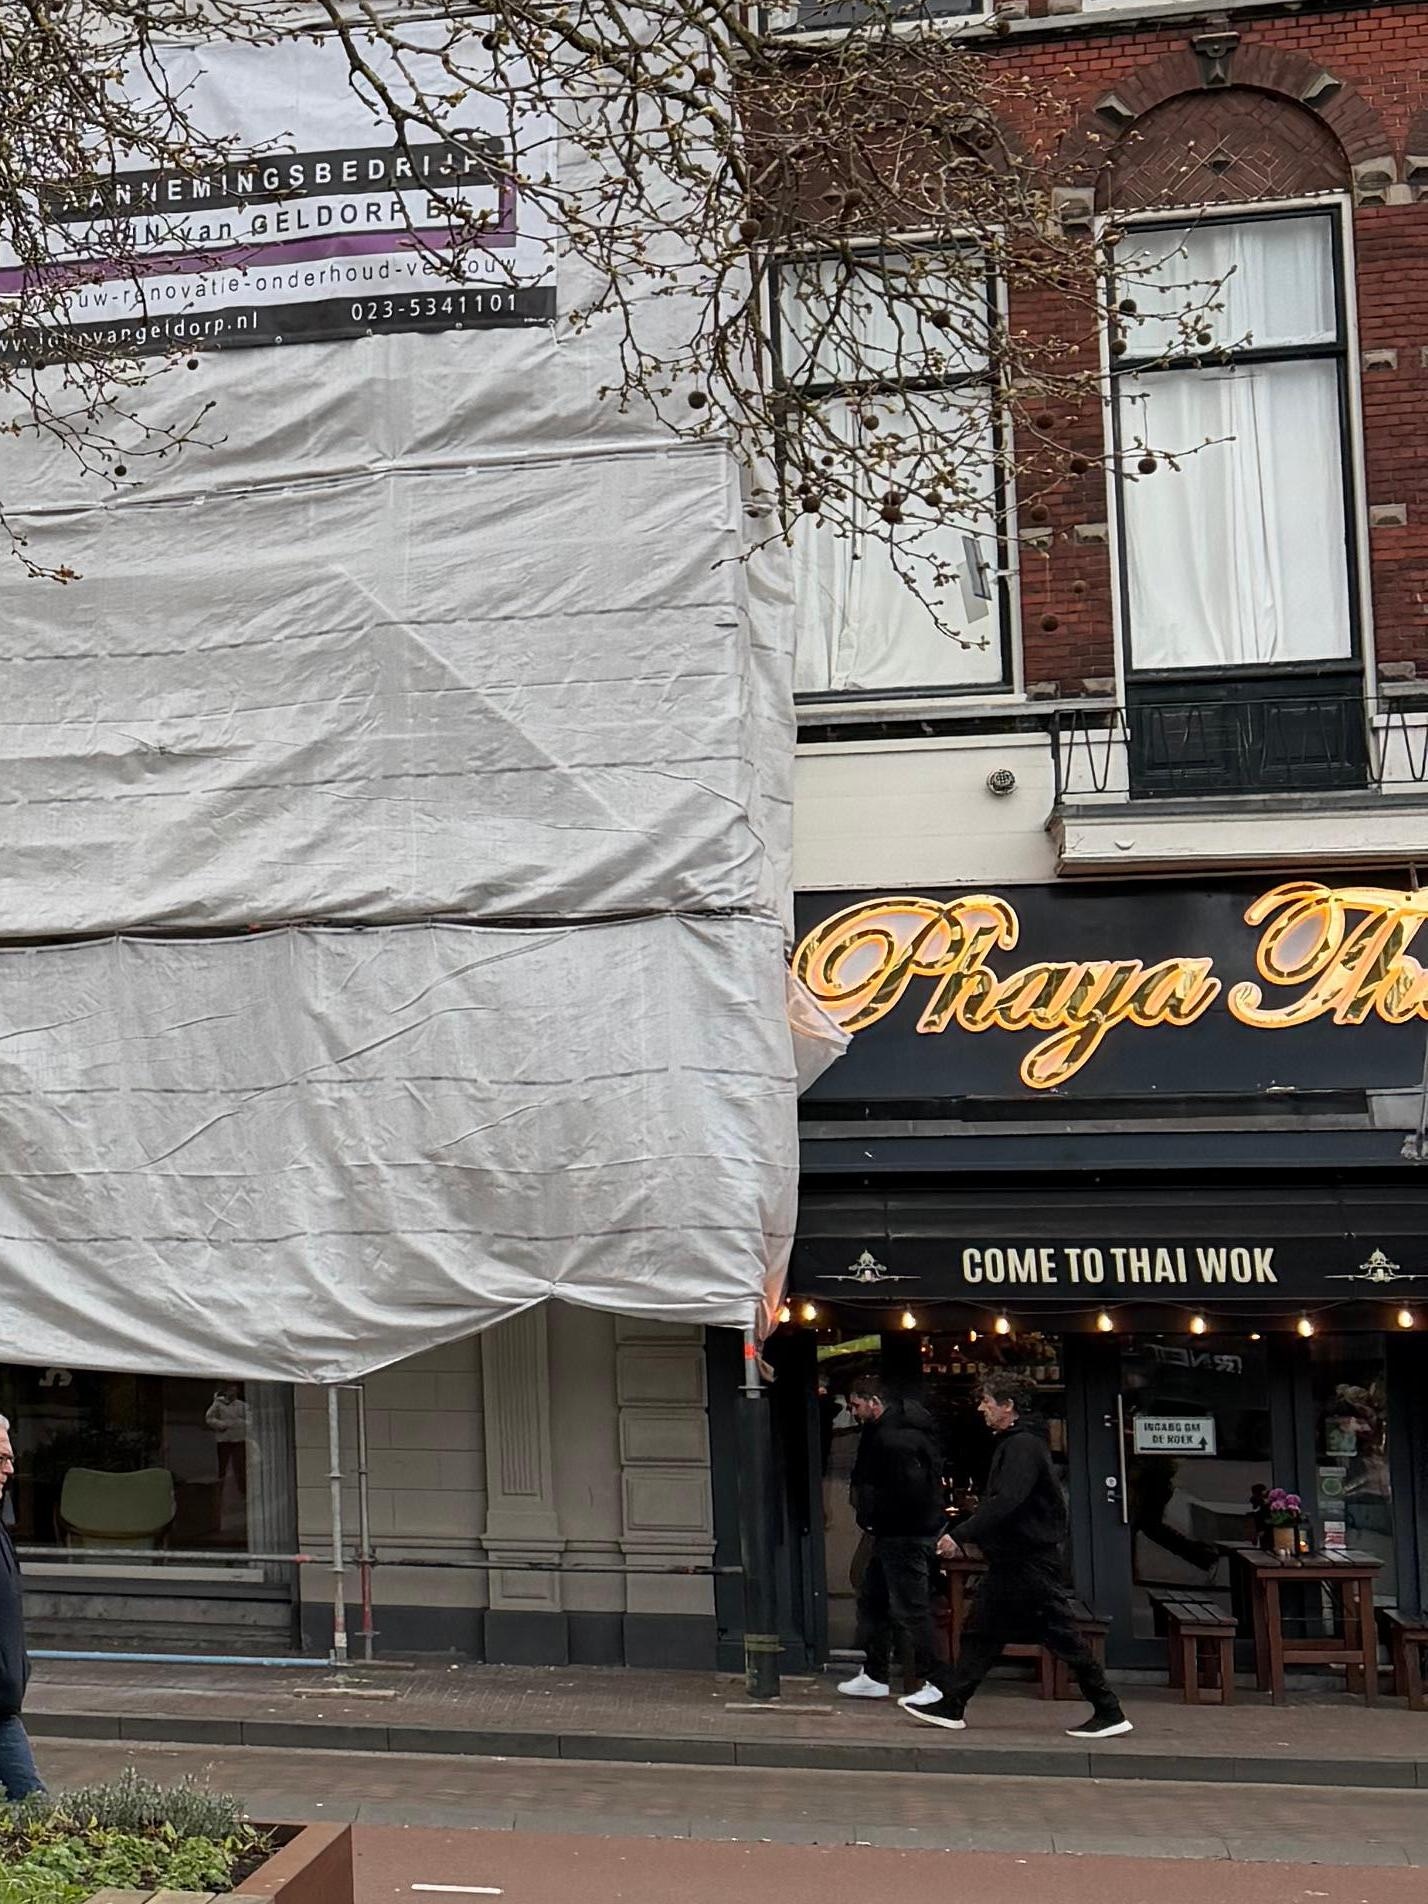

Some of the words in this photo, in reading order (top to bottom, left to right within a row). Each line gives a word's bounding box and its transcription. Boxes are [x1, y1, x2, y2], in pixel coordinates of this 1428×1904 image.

[180, 221, 233, 243] van
[351, 293, 517, 322] 023-5341101
[792, 894, 1221, 1089] Phaya
[963, 1248, 1057, 1284] COME
[1068, 1248, 1106, 1283] TO
[1114, 1248, 1188, 1283] THAI
[1199, 1248, 1278, 1283] WOK
